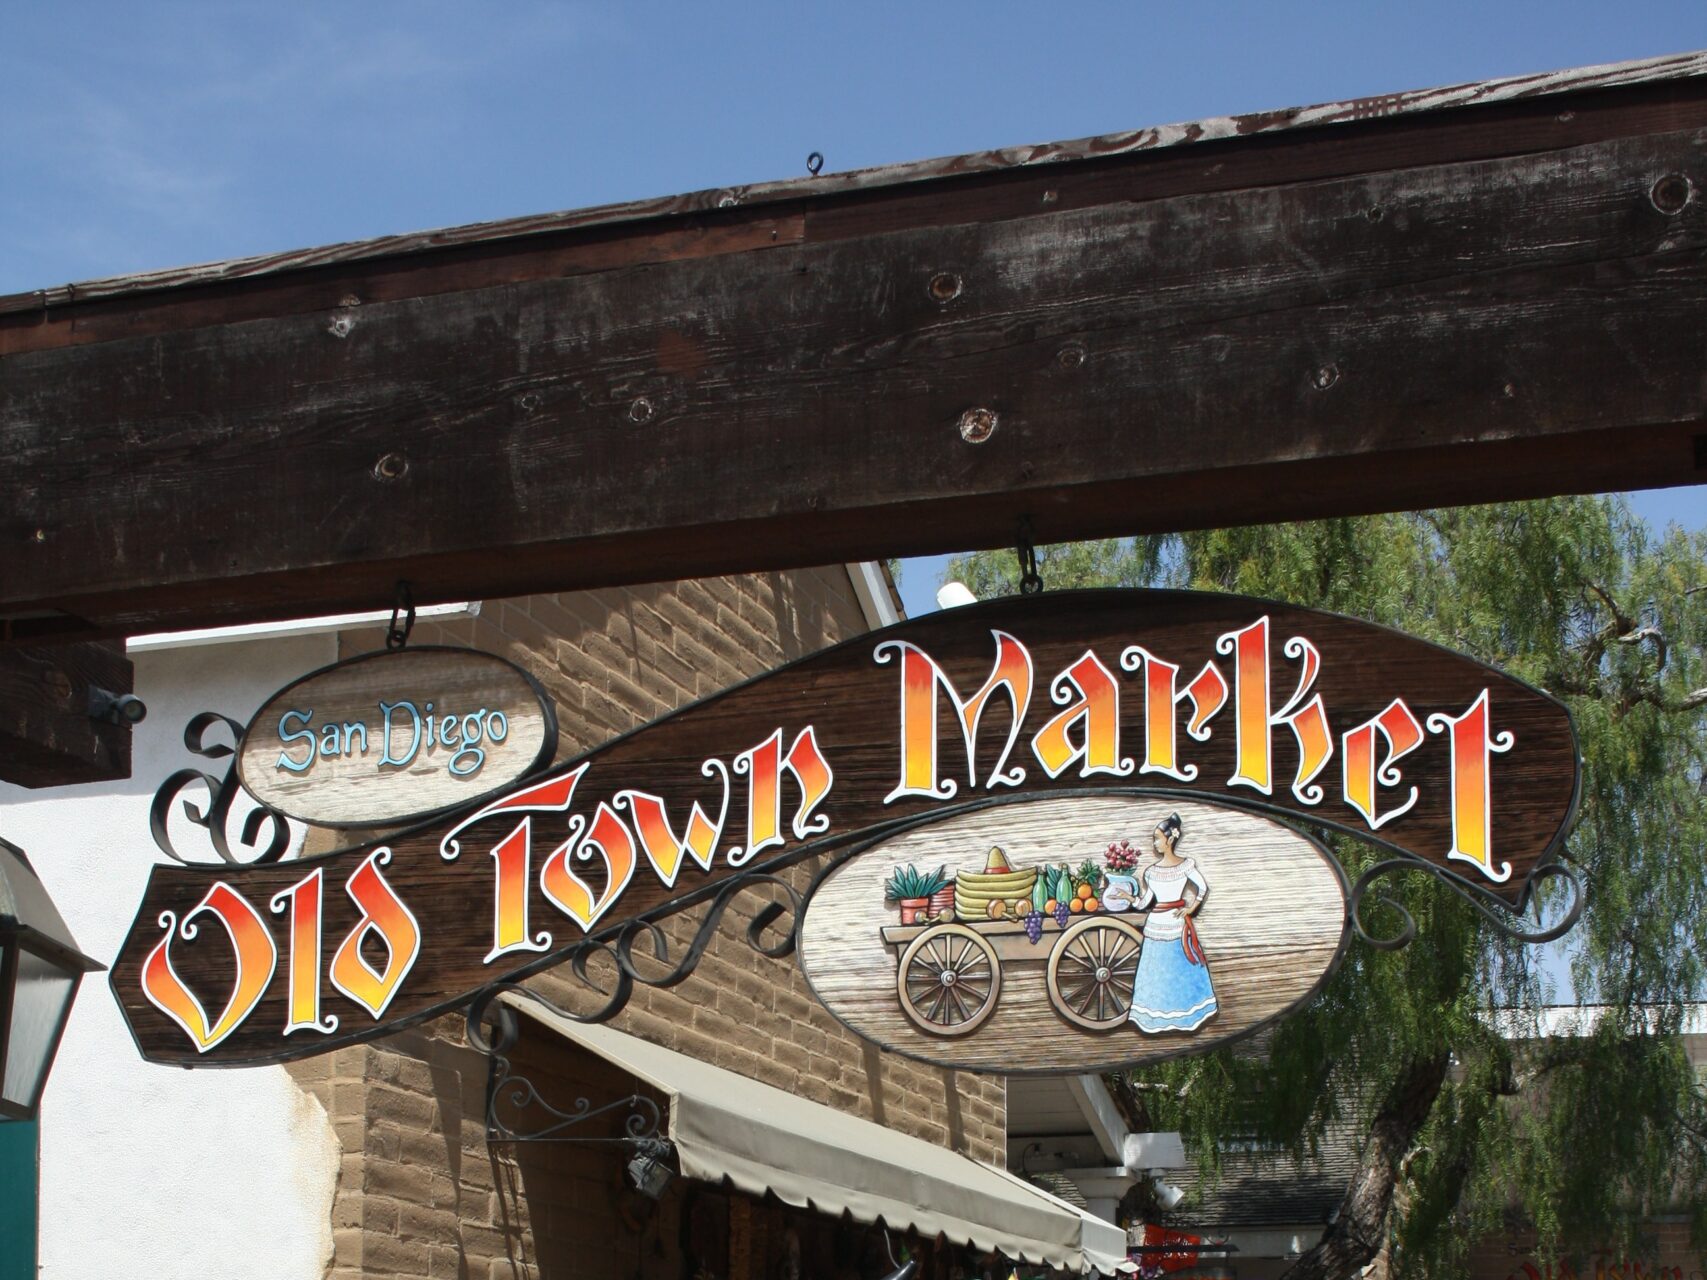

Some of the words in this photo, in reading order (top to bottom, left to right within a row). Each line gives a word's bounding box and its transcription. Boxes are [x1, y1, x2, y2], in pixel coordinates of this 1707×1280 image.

[141, 846, 421, 1054] Old
[440, 725, 834, 965] Town
[873, 615, 1514, 882] Market
[276, 709, 369, 773] San
[377, 701, 509, 776] Diego
